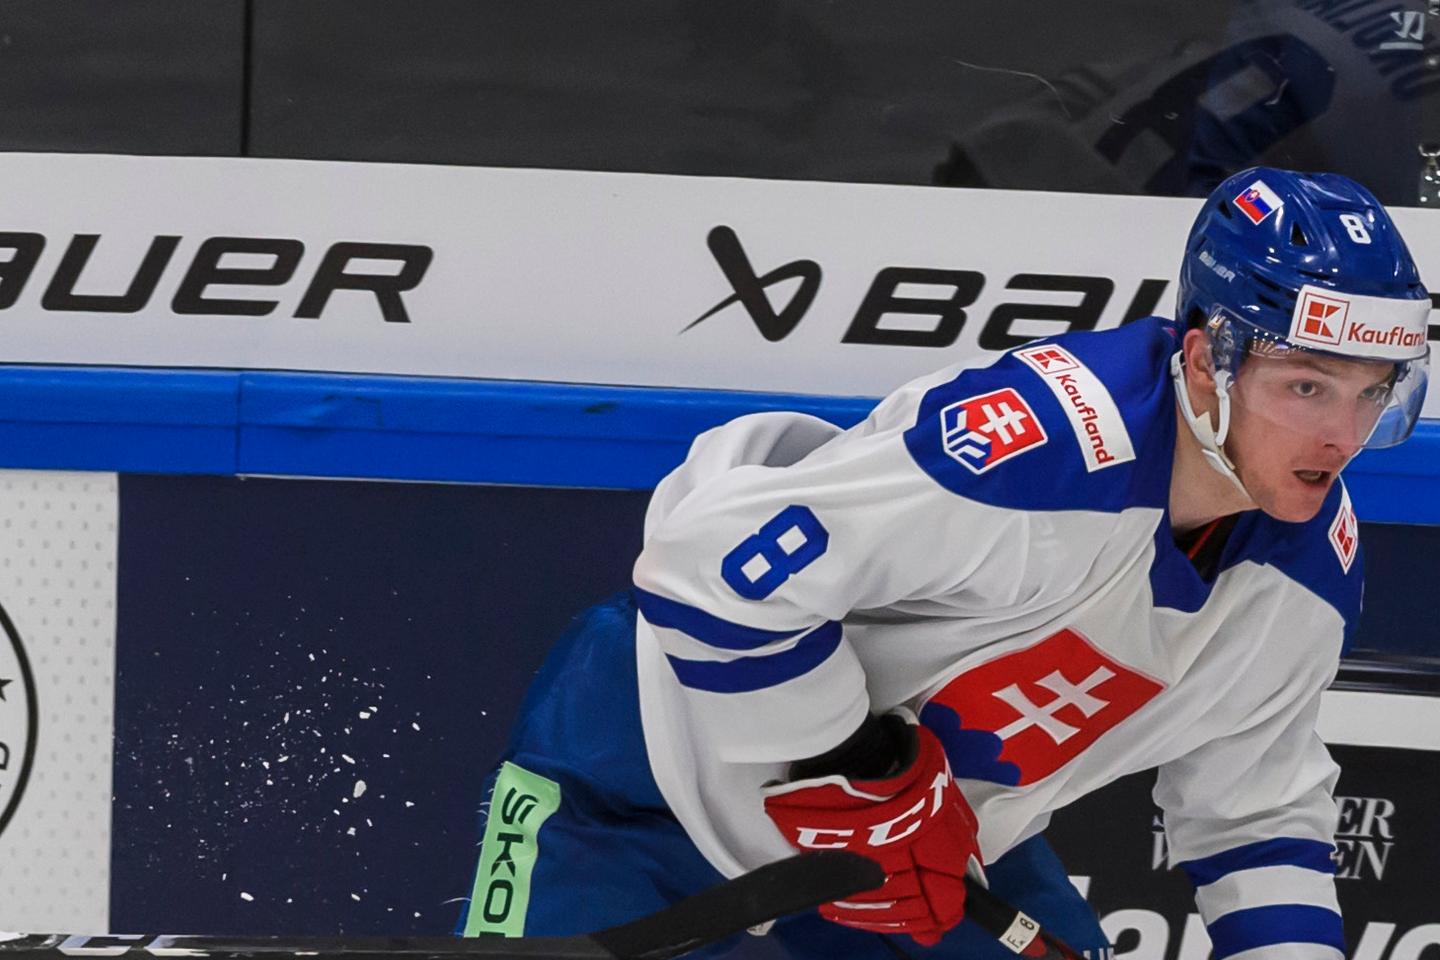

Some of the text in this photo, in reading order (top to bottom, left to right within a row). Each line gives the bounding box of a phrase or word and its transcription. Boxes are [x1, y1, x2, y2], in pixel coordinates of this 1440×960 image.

[1339, 213, 1372, 245] 8
[1056, 374, 1116, 464] Kaufland
[721, 504, 829, 601] 8
